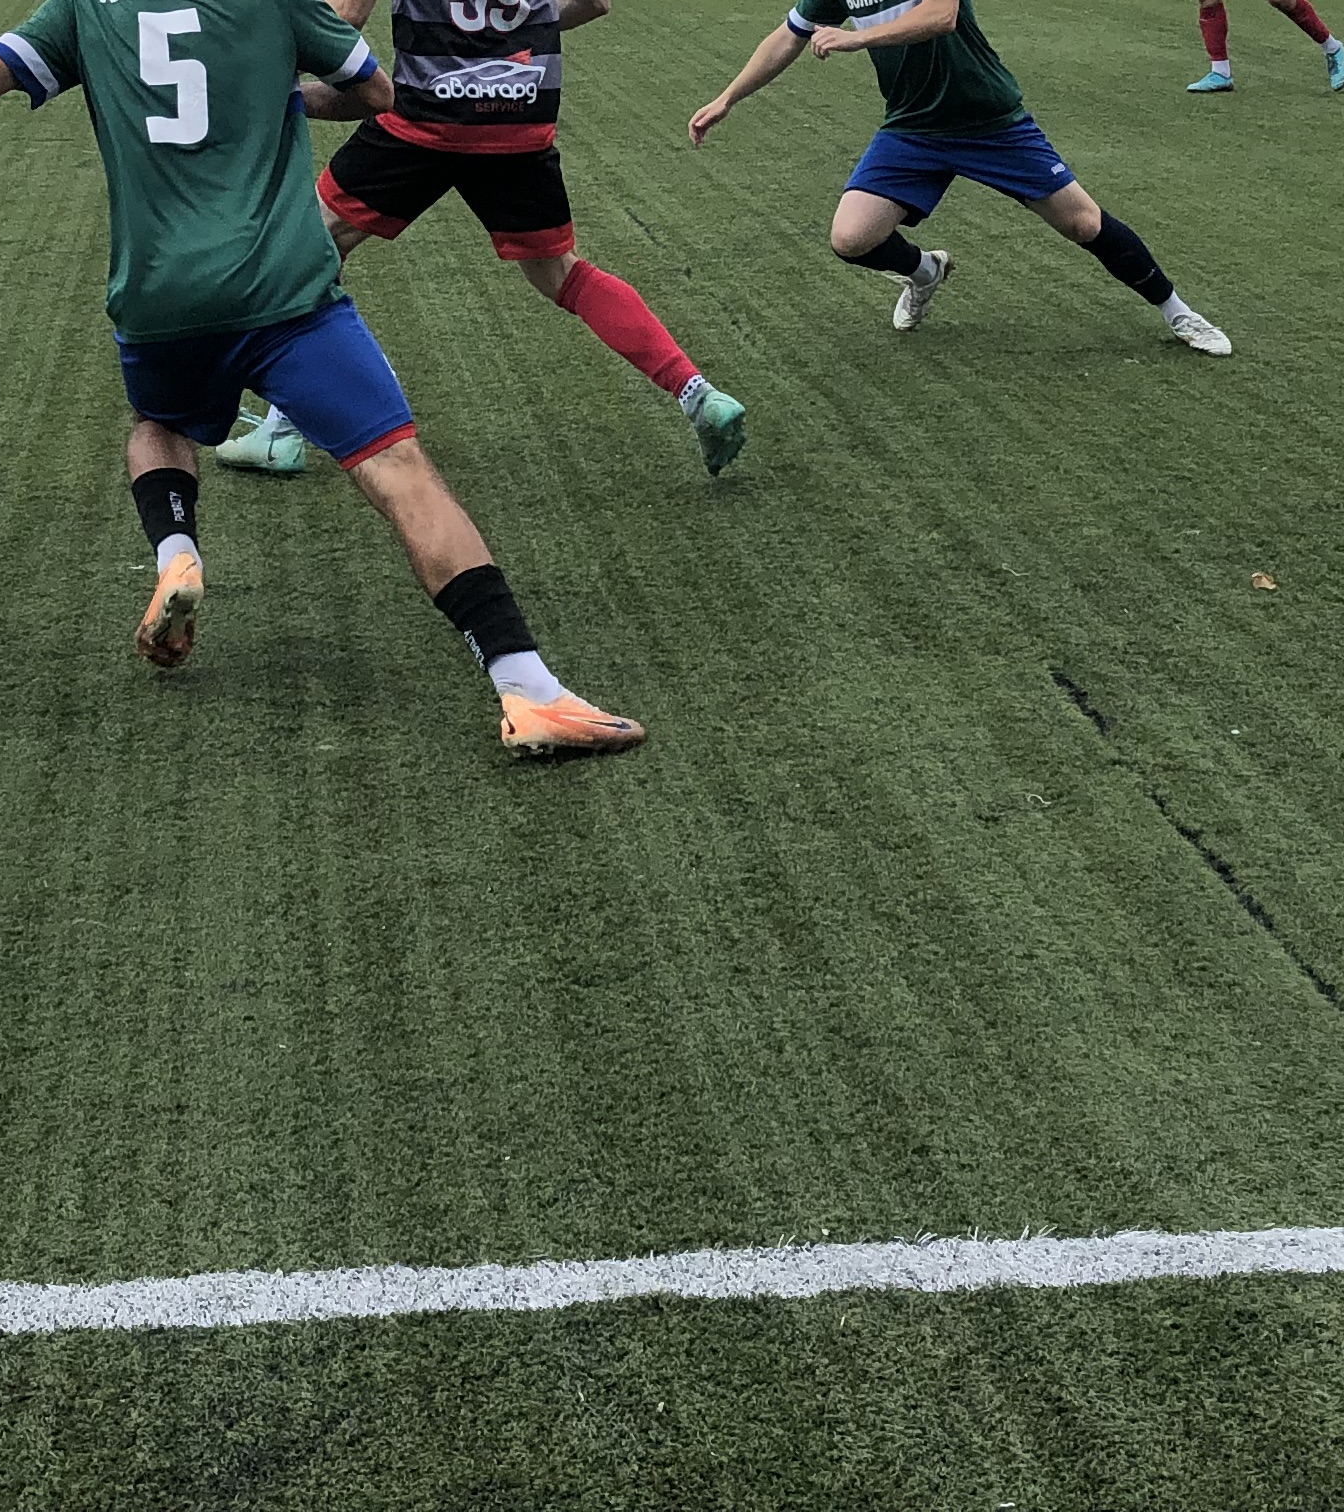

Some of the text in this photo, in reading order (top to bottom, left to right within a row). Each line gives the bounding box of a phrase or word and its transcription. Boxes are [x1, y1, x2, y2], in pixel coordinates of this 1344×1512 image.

[137, 6, 209, 145] 5
[434, 76, 538, 105] авангард
[474, 100, 525, 114] SERVICE
